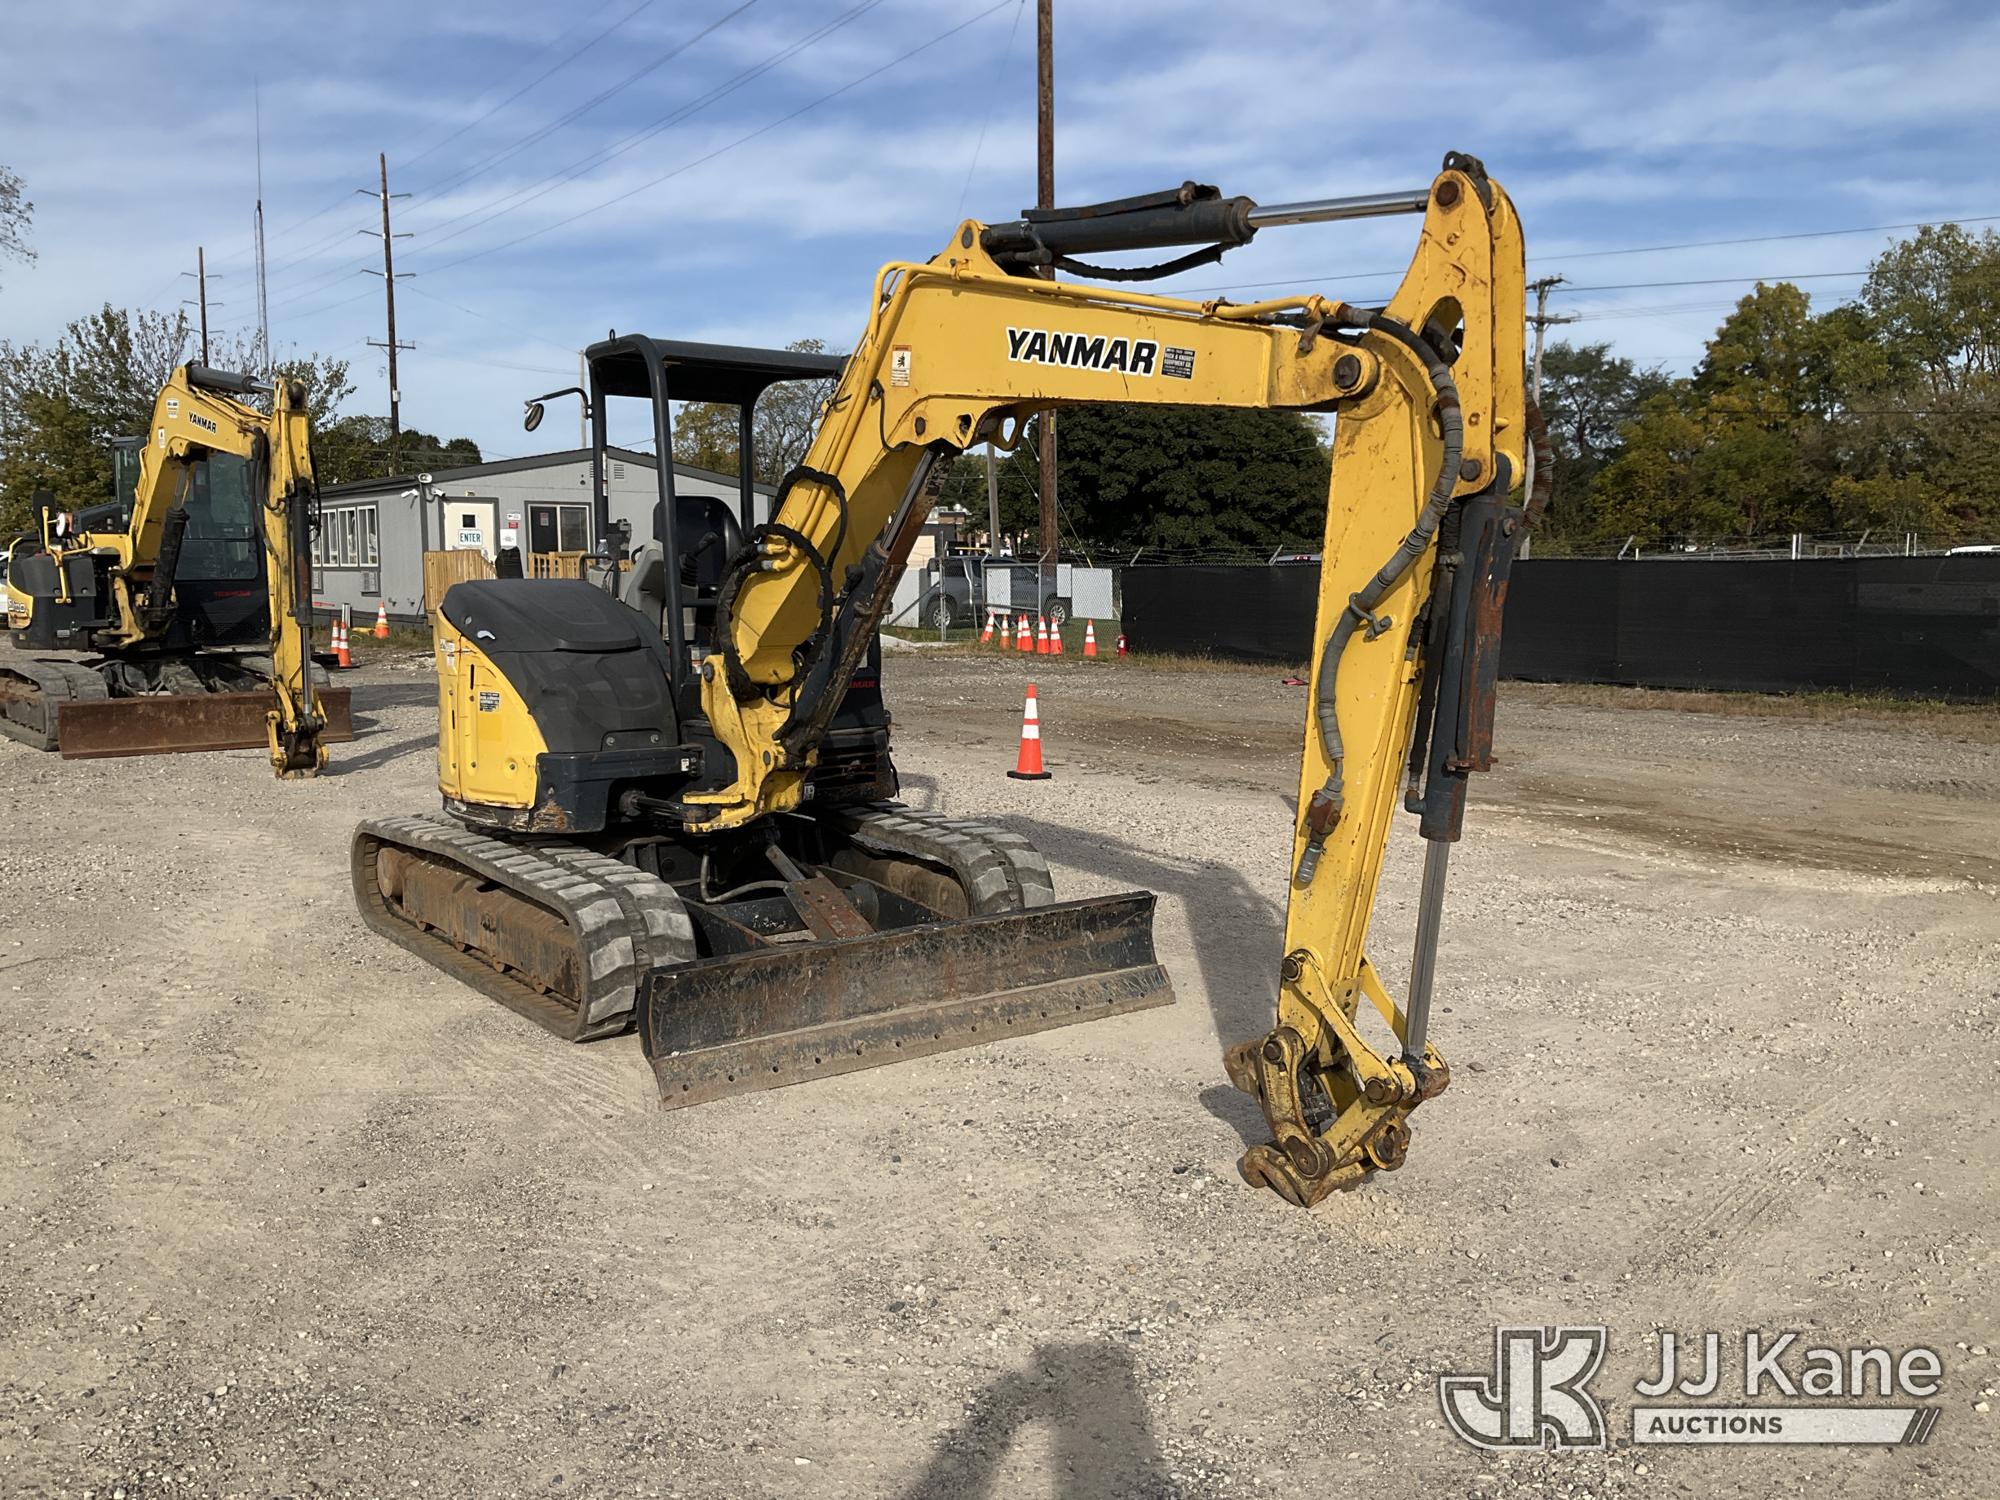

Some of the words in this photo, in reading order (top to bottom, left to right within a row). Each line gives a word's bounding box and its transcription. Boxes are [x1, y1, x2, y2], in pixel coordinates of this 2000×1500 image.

[1006, 328, 1158, 375] YANMAR
[188, 411, 217, 434] YANMAR
[459, 532, 481, 543] ENTER
